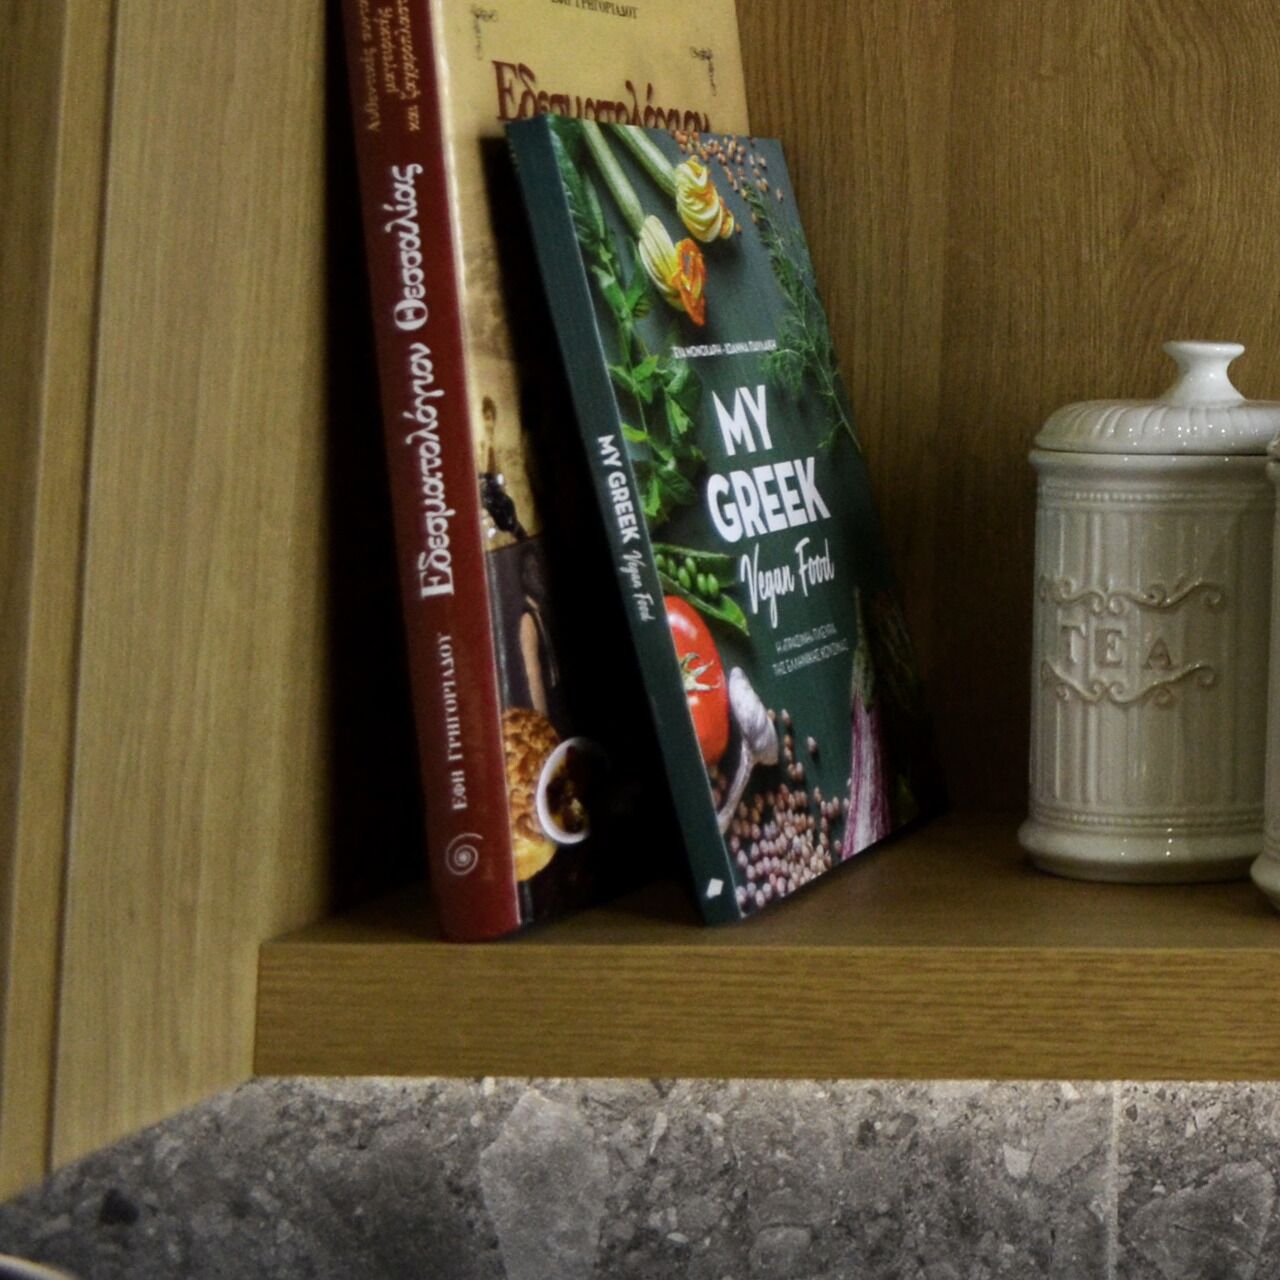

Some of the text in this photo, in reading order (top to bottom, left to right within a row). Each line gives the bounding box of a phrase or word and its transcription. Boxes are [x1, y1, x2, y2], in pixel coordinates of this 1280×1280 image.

[408, 104, 420, 132] και
[382, 163, 455, 599] Εδεσματολόγιον Θεσσαλίας
[598, 434, 622, 467] MY
[711, 384, 773, 456] MY
[607, 471, 641, 544] GREEK
[707, 457, 832, 543] GREEK
[740, 537, 835, 629] Vegan Food
[1061, 624, 1176, 671] TEA
[437, 631, 468, 810] ΕΦΗ ΓΡΗΓΟΡΙΑΔΟΥ
